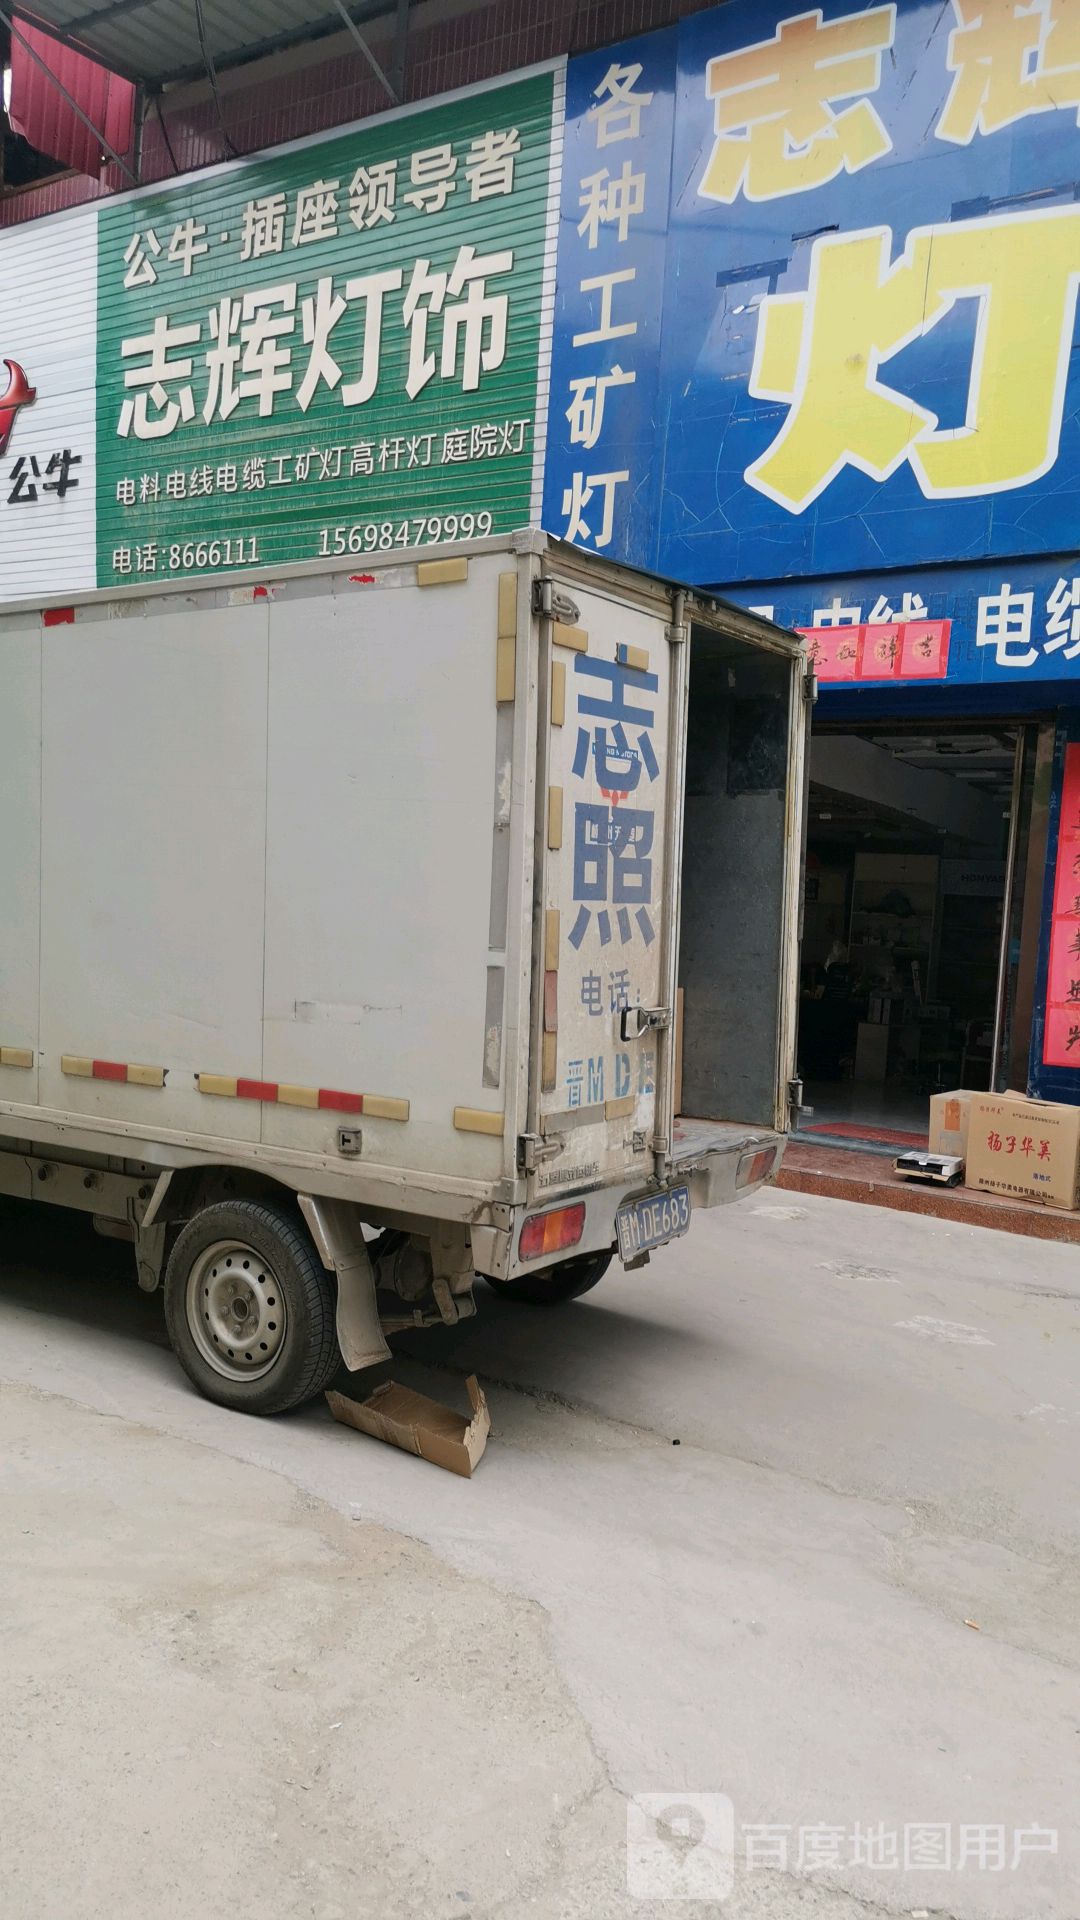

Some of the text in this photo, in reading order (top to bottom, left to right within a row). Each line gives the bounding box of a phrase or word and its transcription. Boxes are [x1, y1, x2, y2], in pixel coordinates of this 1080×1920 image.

[116, 245, 515, 440] 志辉灯饰
[561, 62, 655, 549] 各种工矿灯
[744, 203, 1080, 515] 灯
[7, 449, 82, 504] 公牛
[318, 511, 493, 556] 15698479999
[568, 652, 660, 951] 志照
